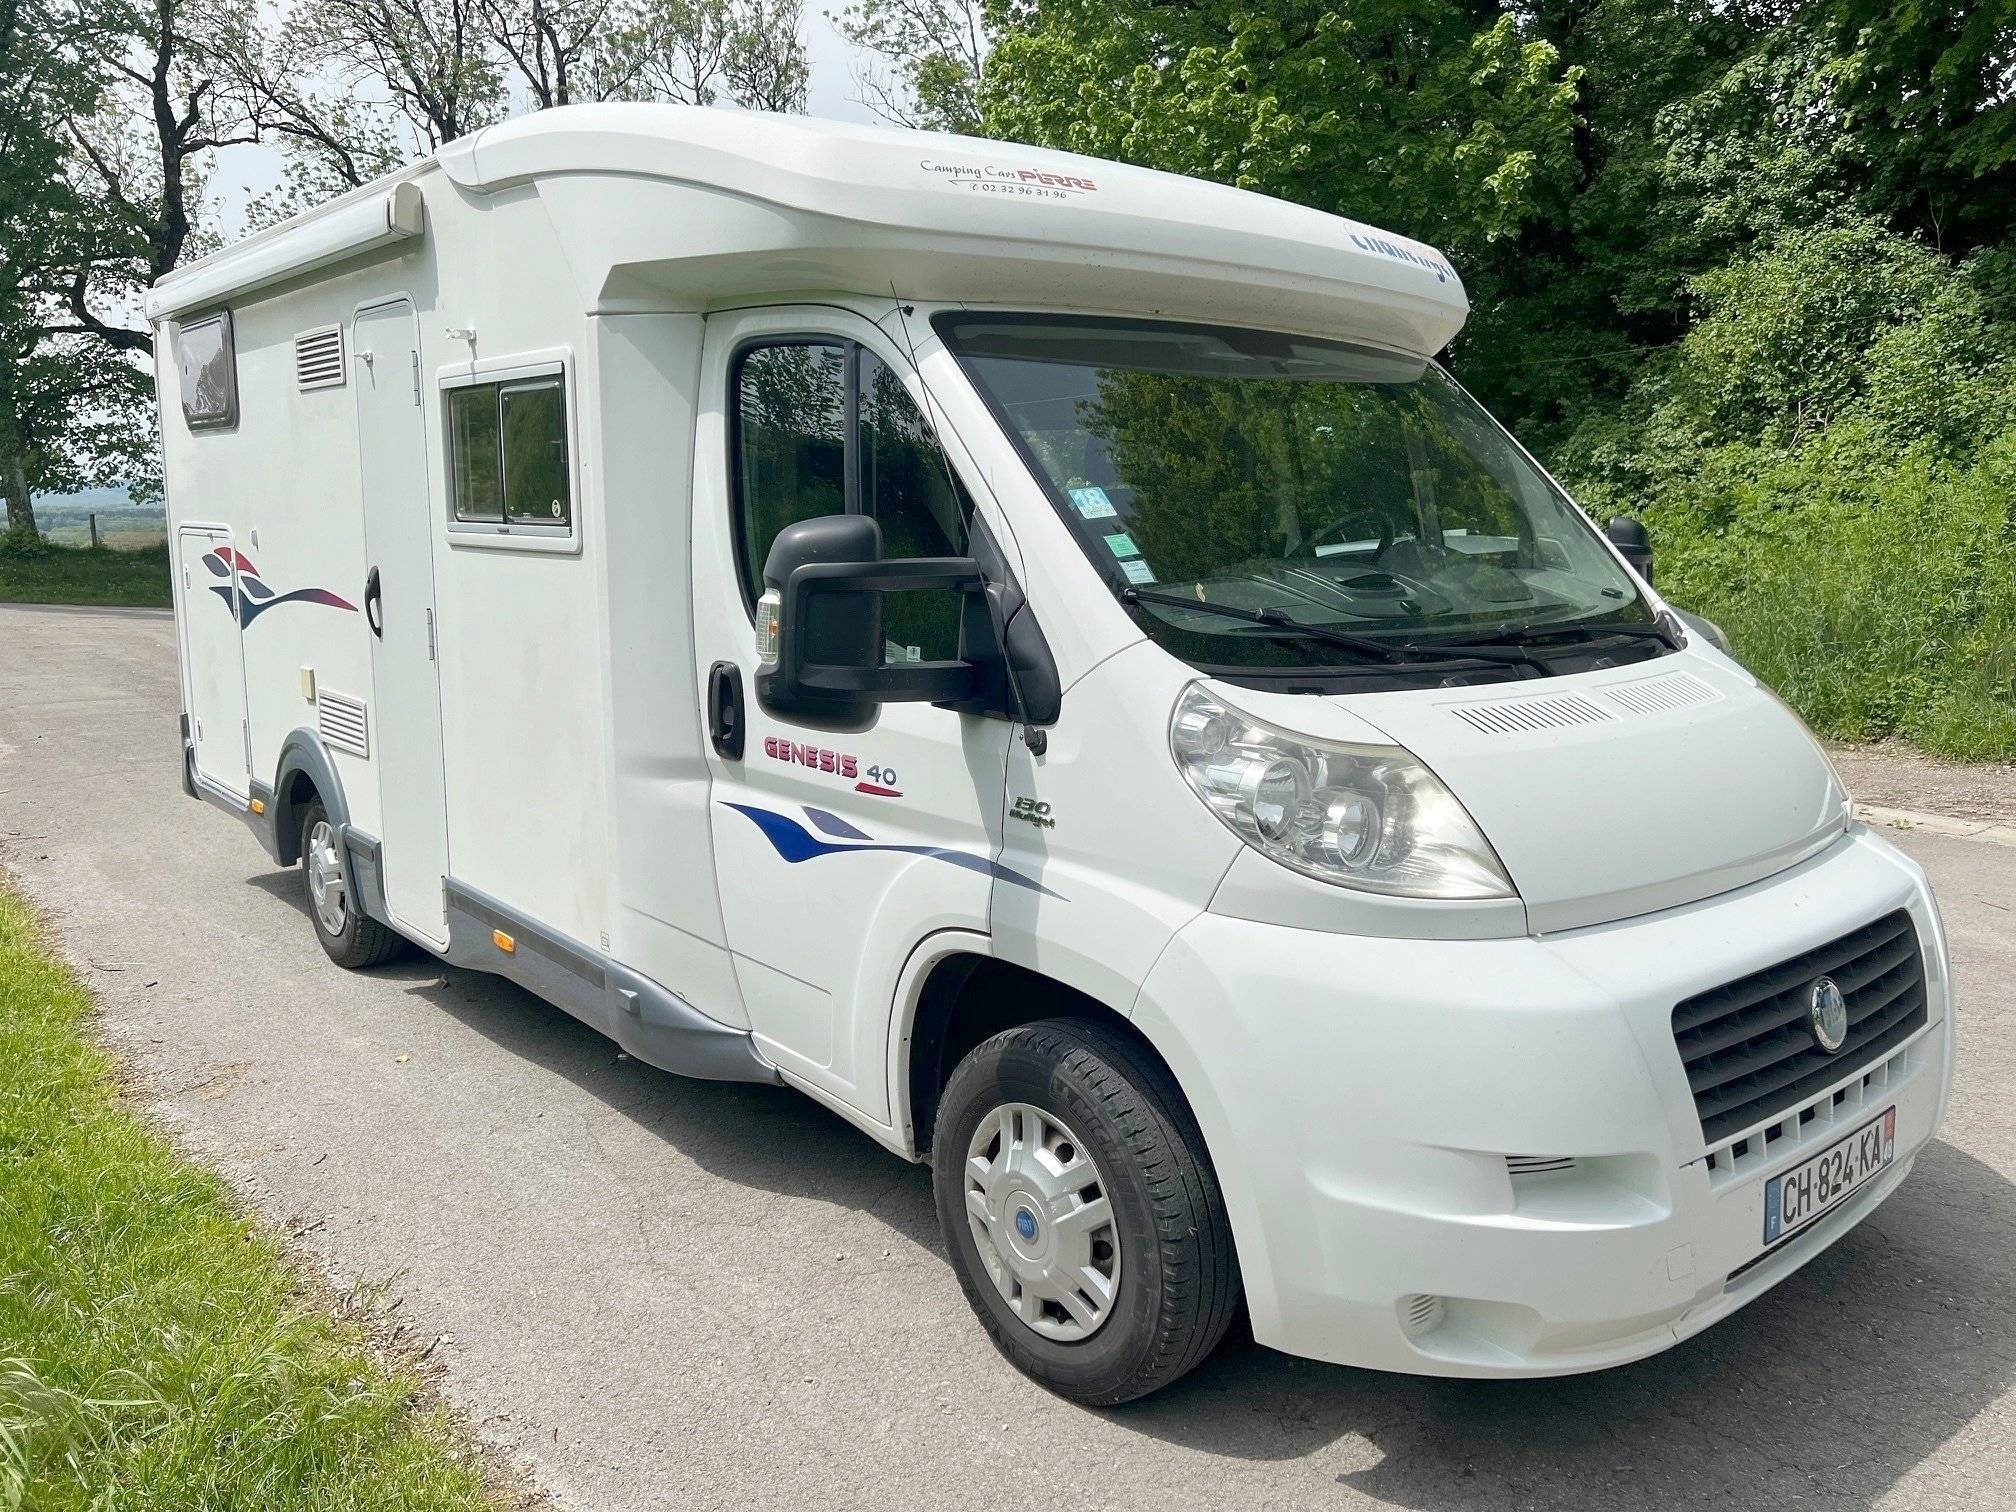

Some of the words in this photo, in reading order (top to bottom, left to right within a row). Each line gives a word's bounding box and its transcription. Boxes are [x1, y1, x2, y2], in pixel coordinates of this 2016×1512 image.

[920, 159, 981, 179] Camping
[984, 165, 1016, 179] Cars
[982, 183, 996, 193] 02
[1001, 184, 1015, 194] 32
[1018, 186, 1033, 196] 96
[1053, 190, 1068, 200] 96
[764, 736, 858, 779] GENESIS
[866, 764, 897, 786] 40
[1014, 796, 1051, 817] 130
